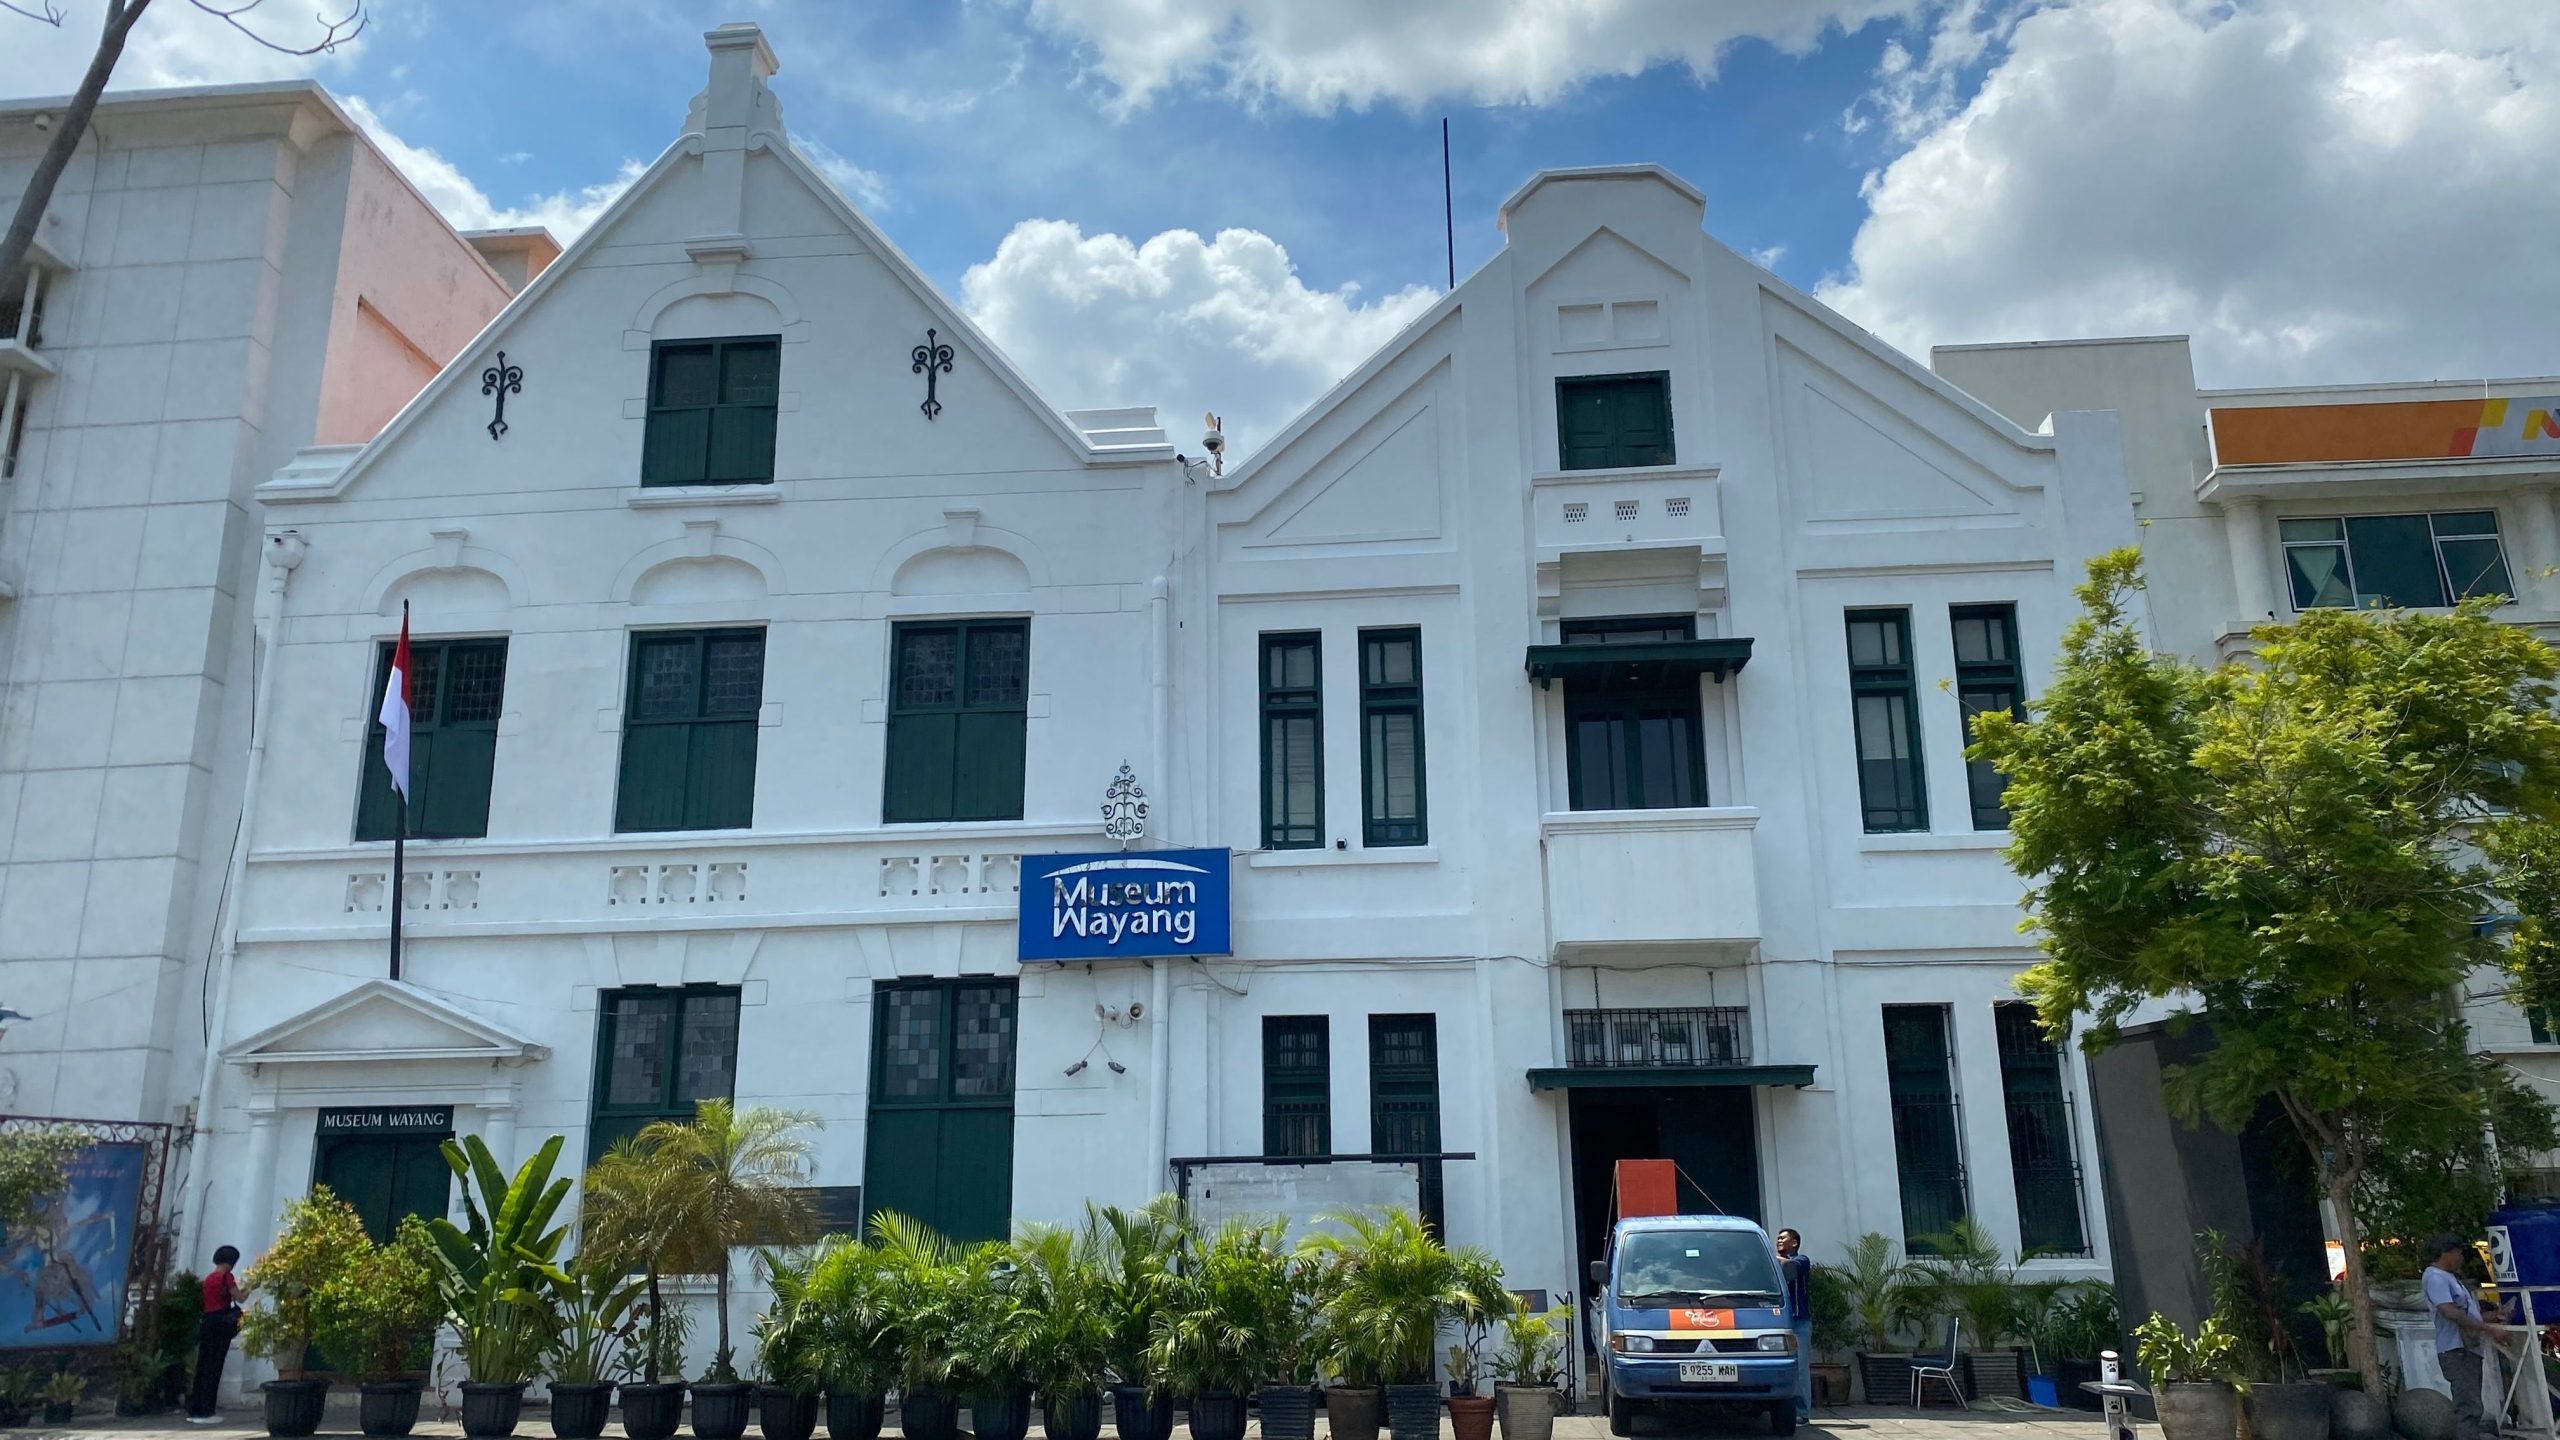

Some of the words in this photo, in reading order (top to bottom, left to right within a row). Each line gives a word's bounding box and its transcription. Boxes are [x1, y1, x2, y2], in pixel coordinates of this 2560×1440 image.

[1053, 876, 1196, 907] Museum
[1053, 907, 1196, 945] Wayang
[324, 1113, 382, 1128] MUSEUM
[389, 1112, 445, 1127] WAYANG
[1681, 1365, 1688, 1376] B
[1690, 1365, 1714, 1376] 9255
